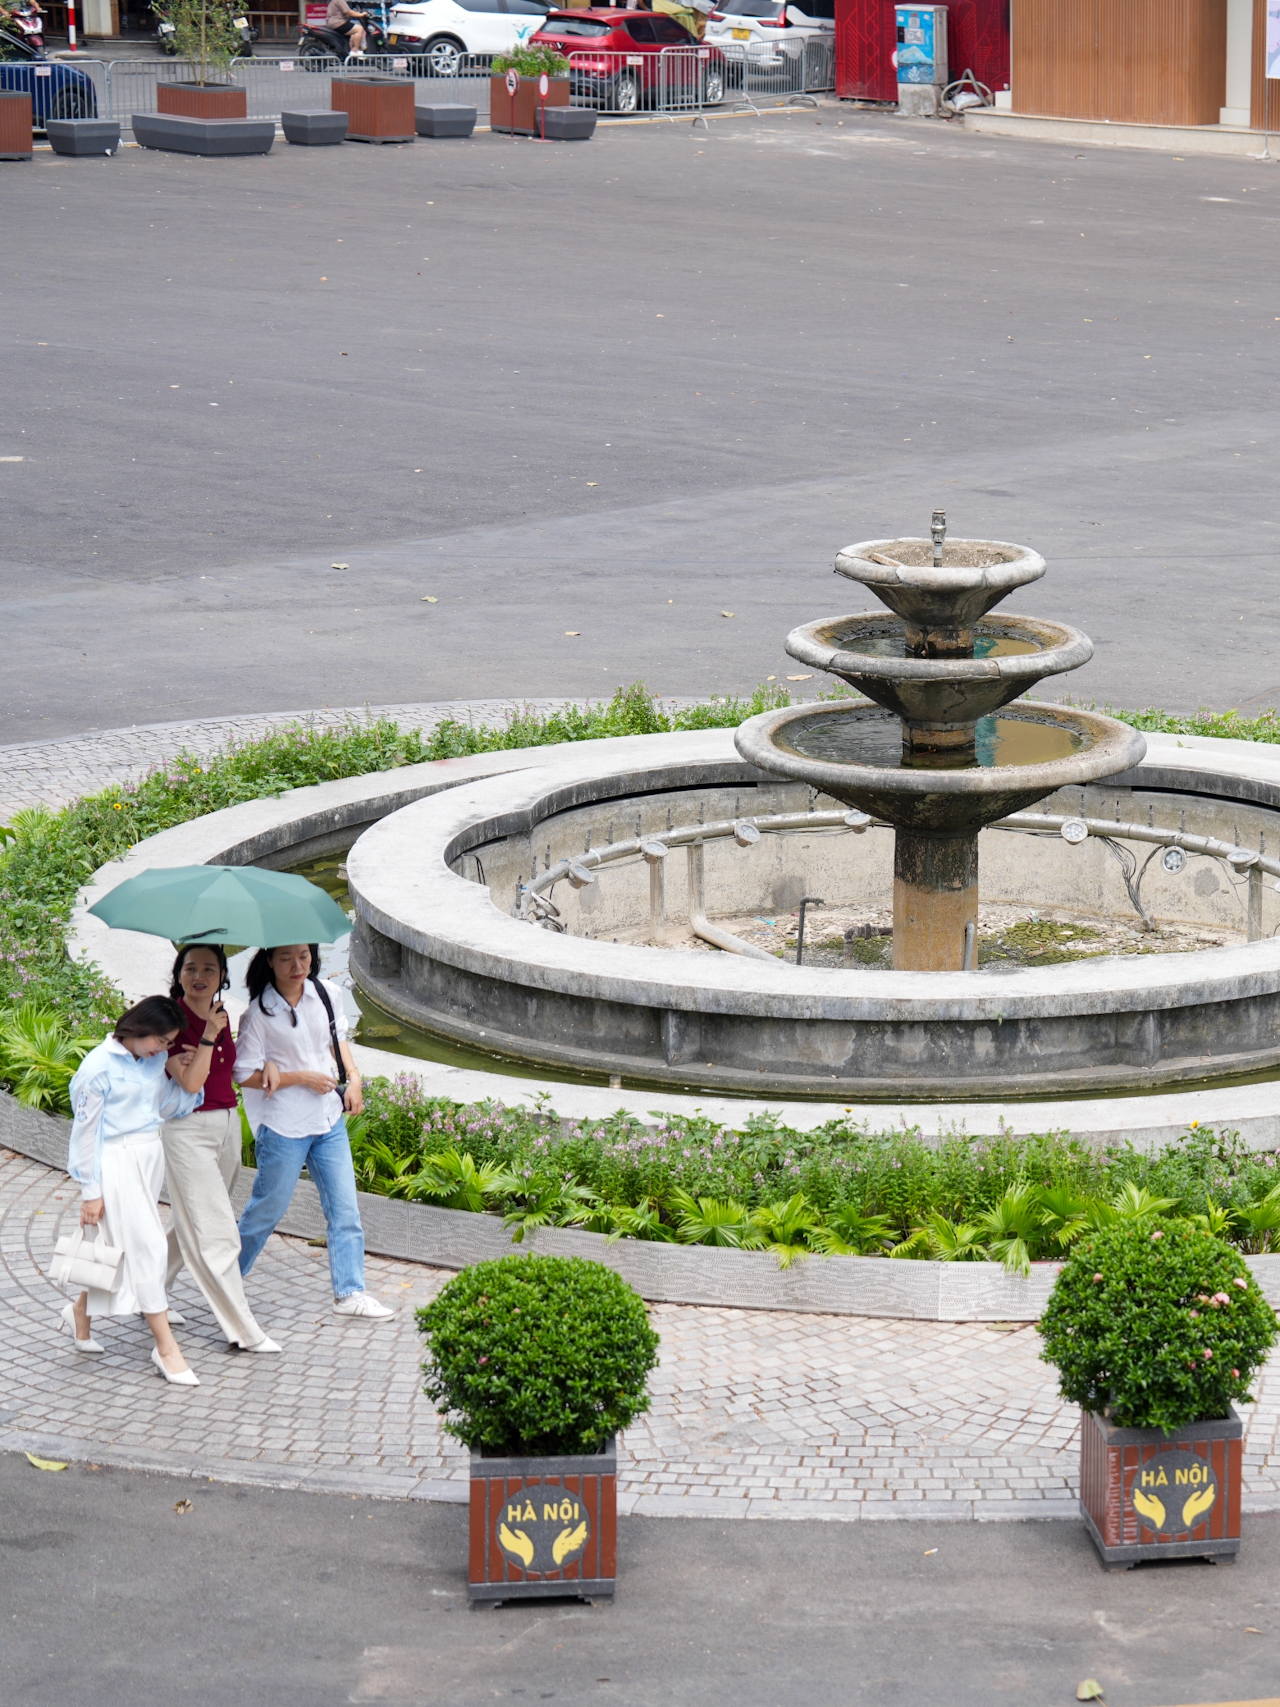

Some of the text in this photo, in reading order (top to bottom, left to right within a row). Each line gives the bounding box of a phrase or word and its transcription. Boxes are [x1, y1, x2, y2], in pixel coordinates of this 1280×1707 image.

[1141, 1463, 1208, 1488] HÀ NỘI
[507, 1497, 580, 1525] HÀ NỘI
